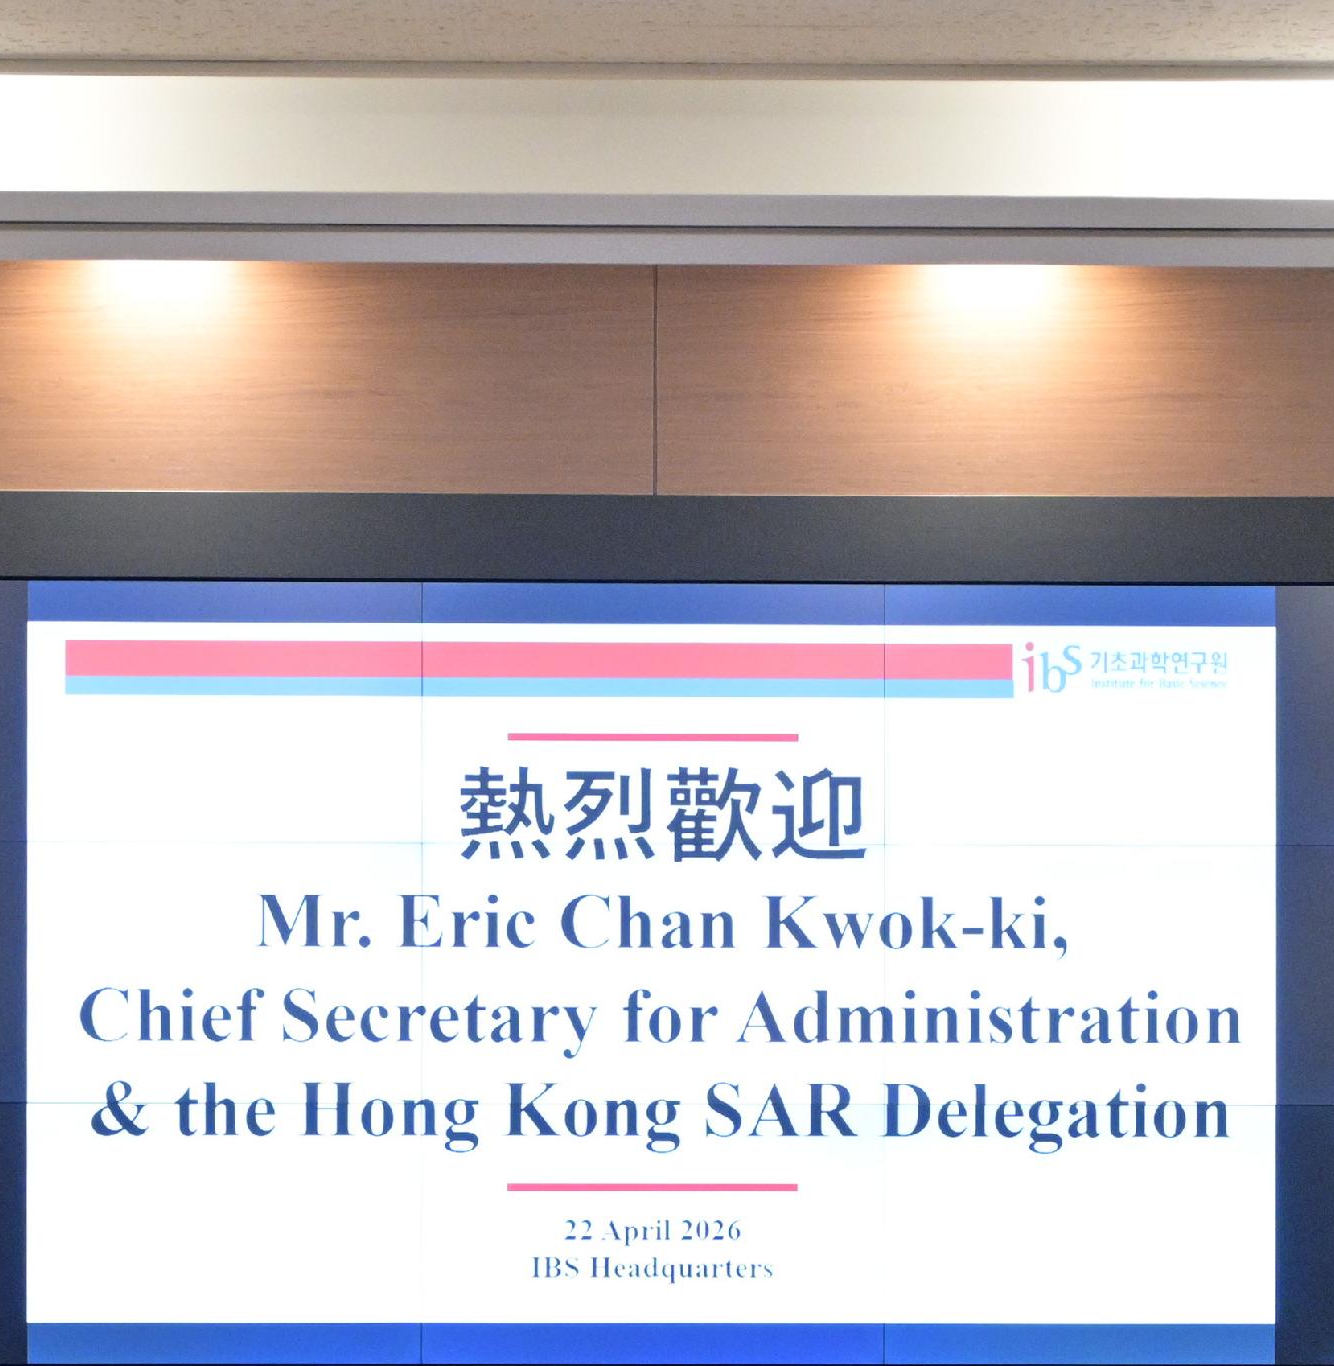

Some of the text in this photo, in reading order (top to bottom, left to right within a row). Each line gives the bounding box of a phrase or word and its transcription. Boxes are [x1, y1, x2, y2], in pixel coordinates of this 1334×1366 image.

[1090, 651, 1228, 675] 기초과학연구원
[1091, 679, 1227, 689] Institute for Basic Science
[460, 765, 868, 862] 熱烈歡迎
[259, 894, 1069, 958] Mr. Eric Chan Kwok-ki,
[79, 986, 1242, 1060] Chief Secretary for Administration
[91, 1080, 1230, 1155] & the Hong Kong SAR Delegation
[564, 1219, 742, 1247] 22 April 2026
[532, 1256, 774, 1284] IBS Headquarters
